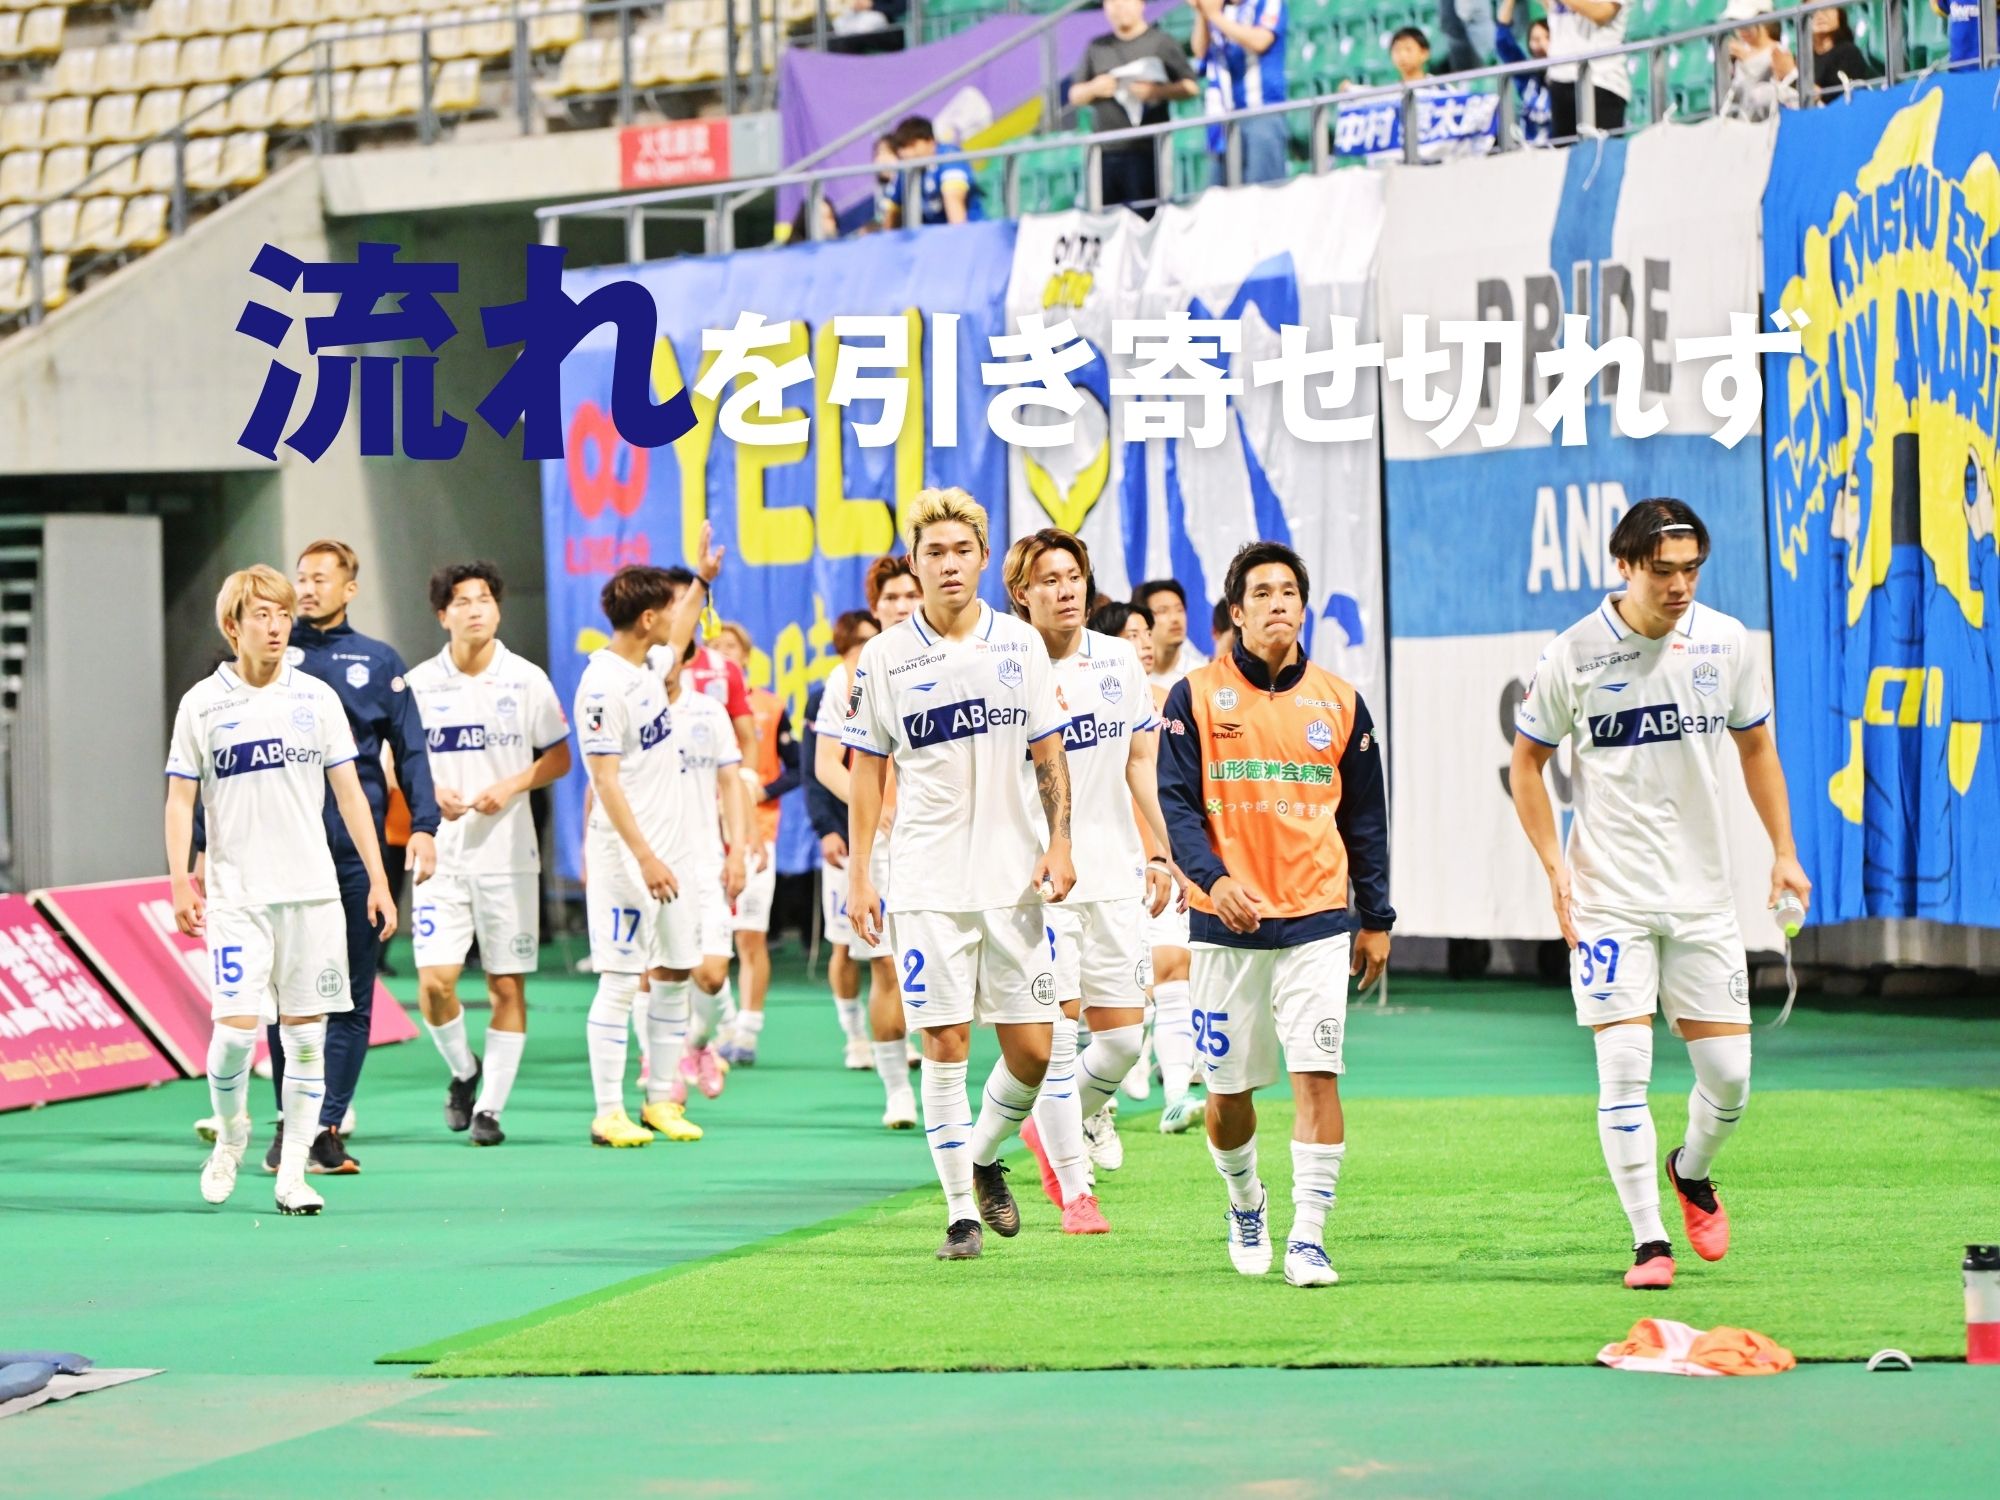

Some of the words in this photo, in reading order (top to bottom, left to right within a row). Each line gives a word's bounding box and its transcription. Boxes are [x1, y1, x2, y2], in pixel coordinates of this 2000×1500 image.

[1528, 481, 1634, 593] AND
[888, 662, 918, 677] NISSAN
[919, 653, 947, 667] GROUP
[1576, 659, 1608, 674] NISSAN
[1610, 651, 1641, 665] GROUP
[1212, 731, 1244, 739] PENALTY
[1209, 759, 1334, 785] 山形徳洲会病院
[612, 907, 641, 942] 17
[213, 946, 244, 985] 15
[904, 949, 925, 992] 2
[1577, 937, 1620, 987] 39
[1191, 1009, 1230, 1057] 25
